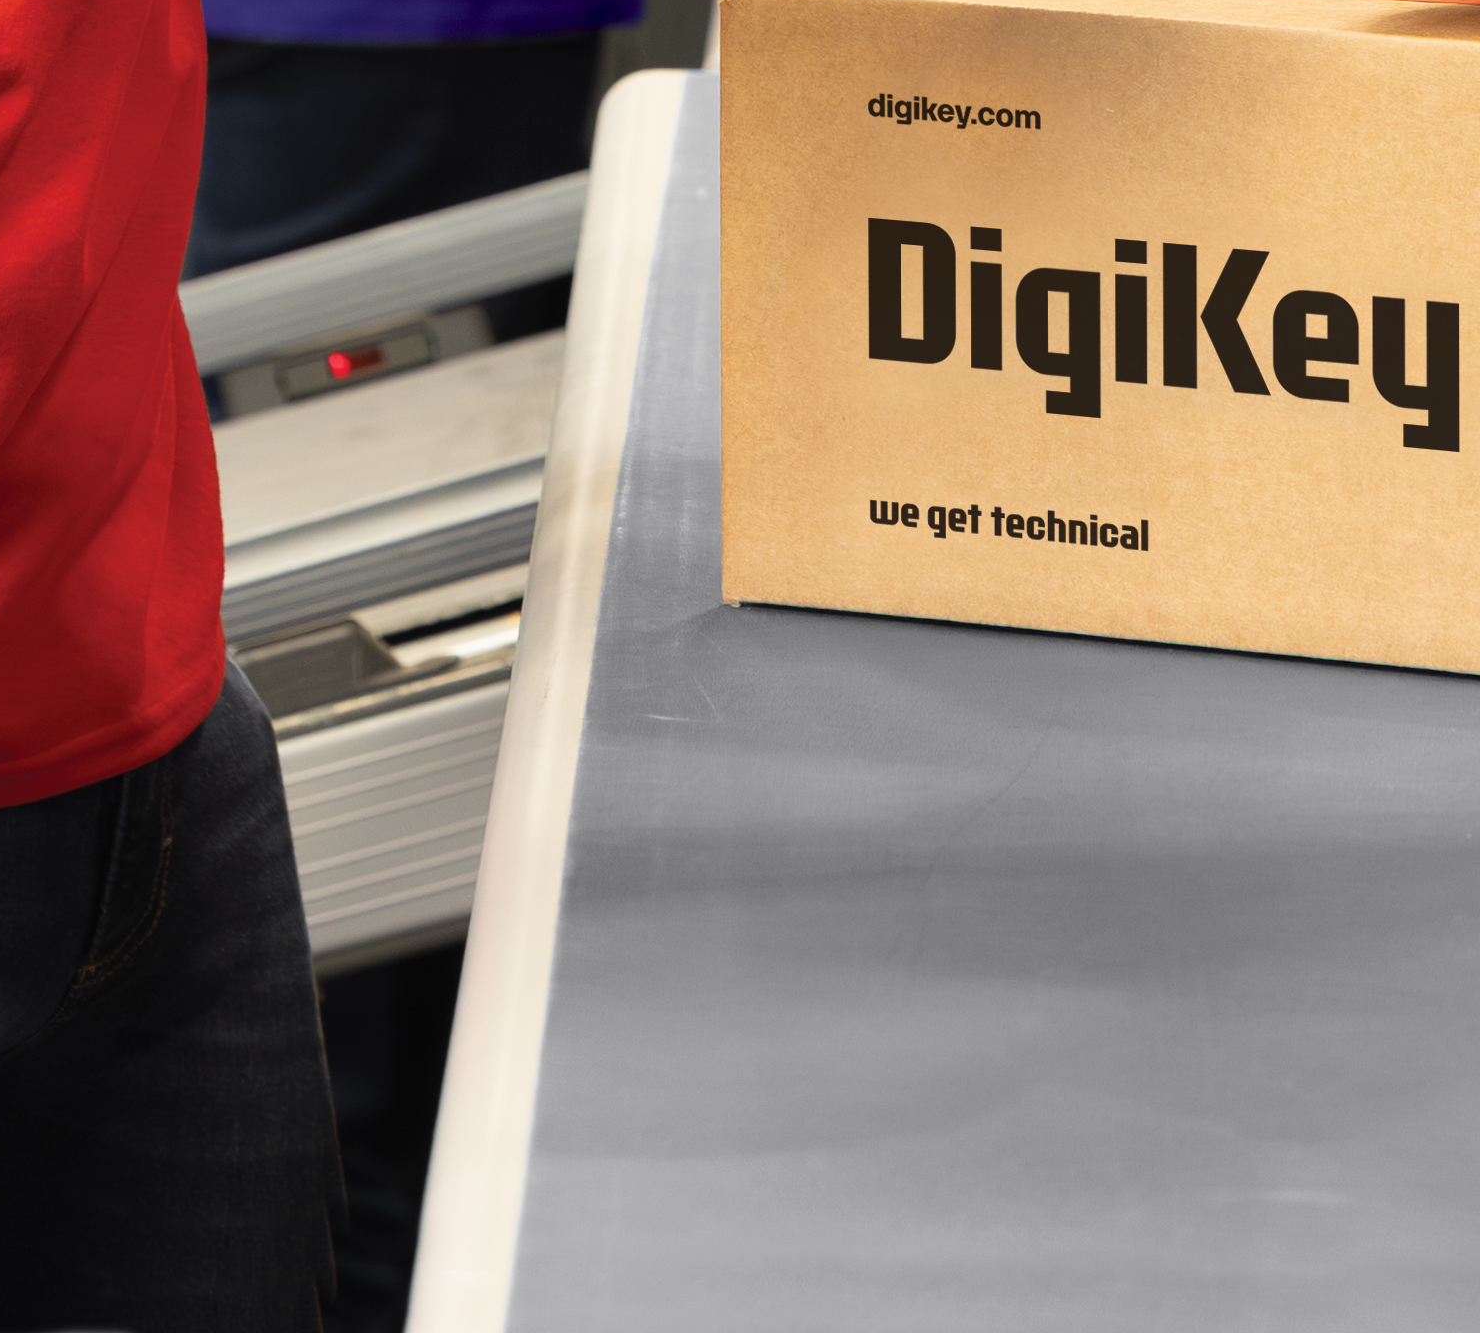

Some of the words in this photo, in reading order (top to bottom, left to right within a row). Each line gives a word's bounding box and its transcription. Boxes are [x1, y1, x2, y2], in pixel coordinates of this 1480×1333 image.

[867, 93, 1041, 130] digikey.com
[868, 217, 1460, 453] DigiKey
[869, 499, 920, 528] we
[927, 504, 982, 539] get
[990, 506, 1149, 552] technical
